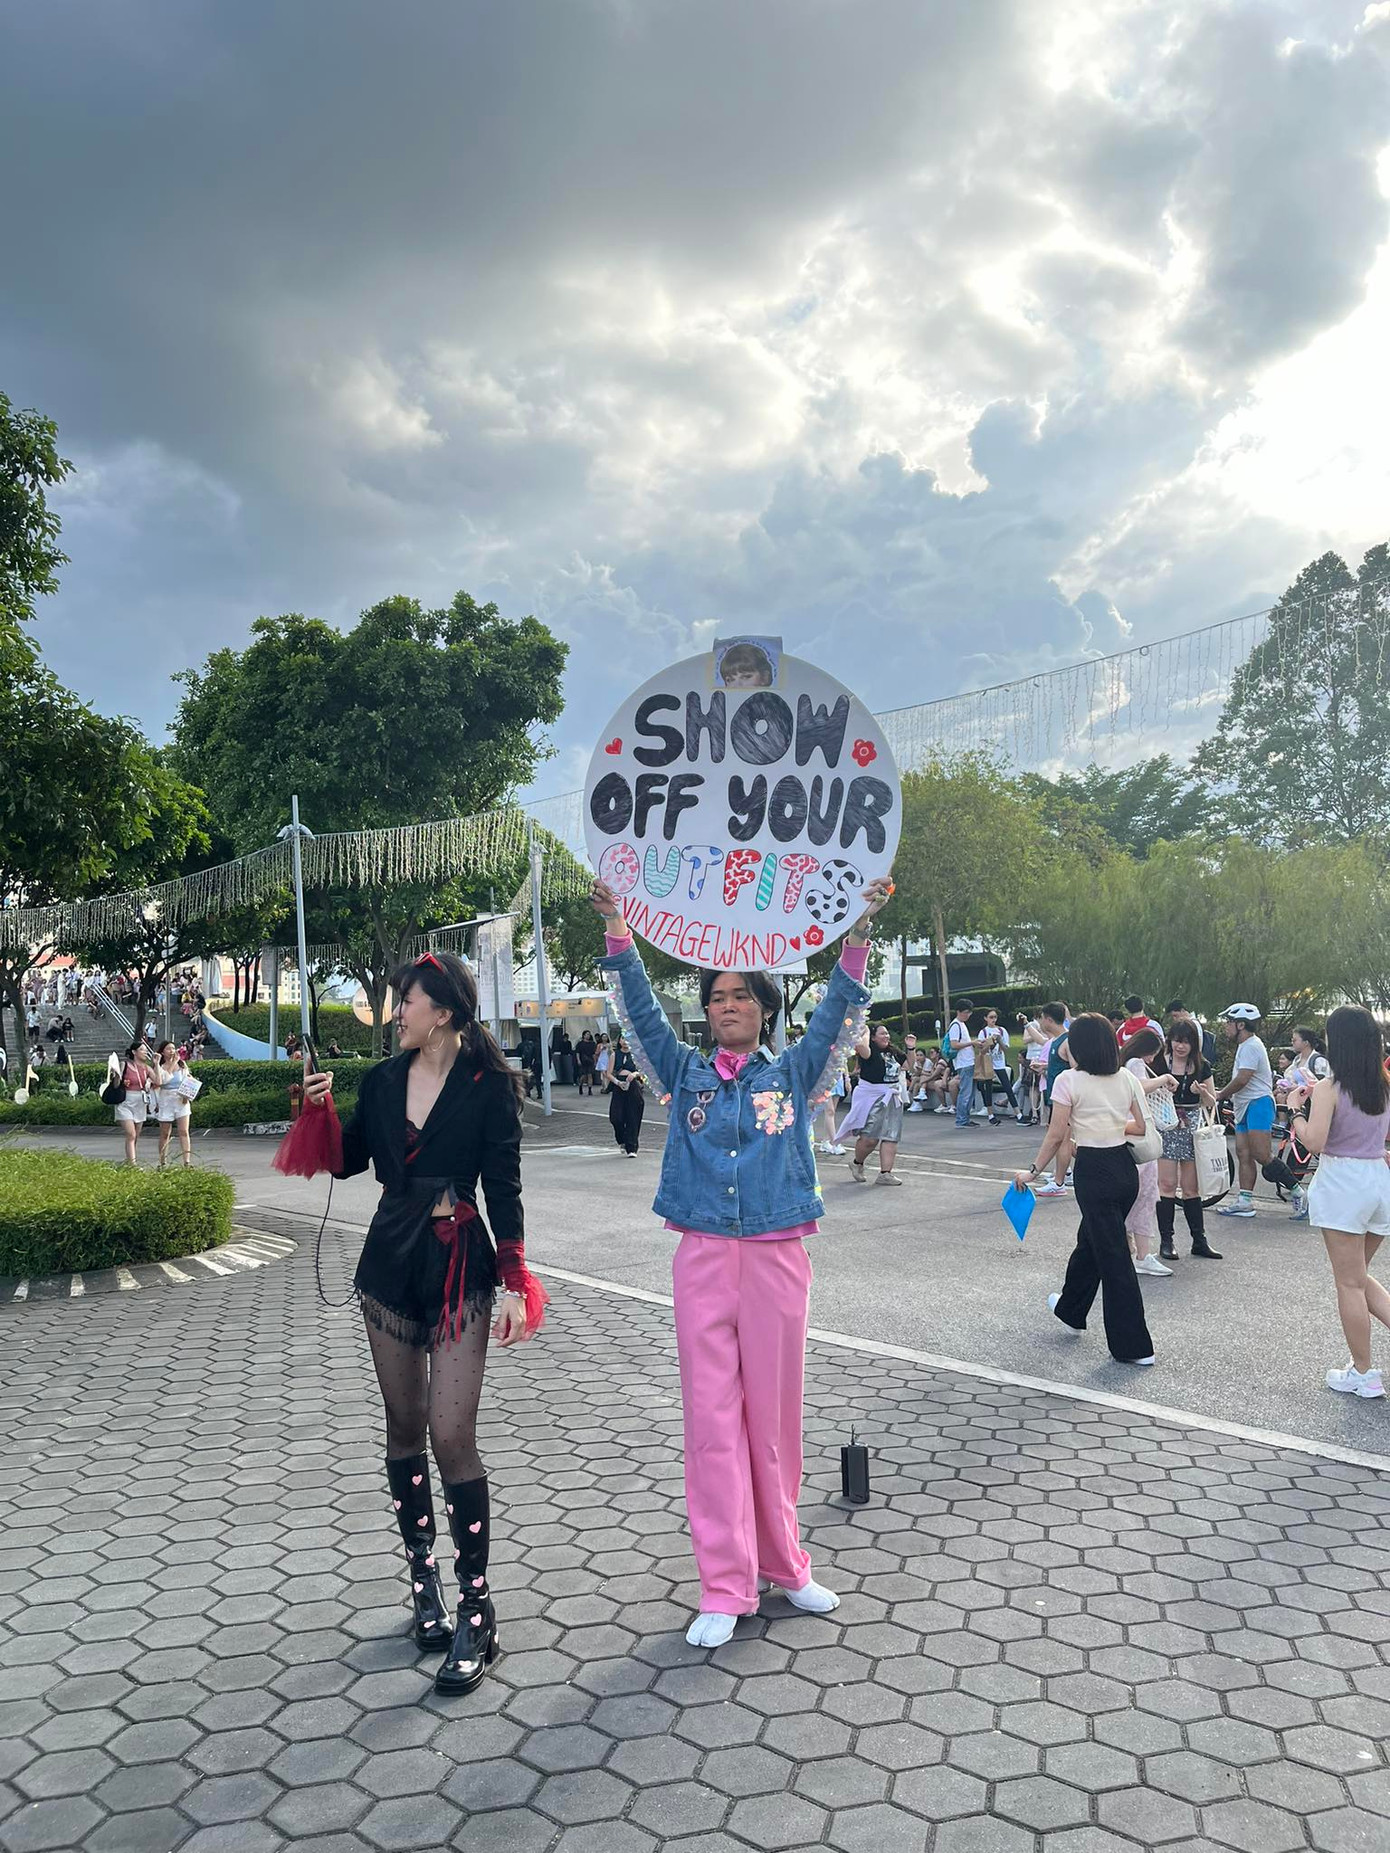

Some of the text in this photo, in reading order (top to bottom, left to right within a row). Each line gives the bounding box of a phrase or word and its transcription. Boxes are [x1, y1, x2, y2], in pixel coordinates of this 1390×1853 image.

[633, 690, 850, 769] SHOW
[590, 772, 894, 854] OFF YOUR
[598, 842, 864, 925] OUTFITS
